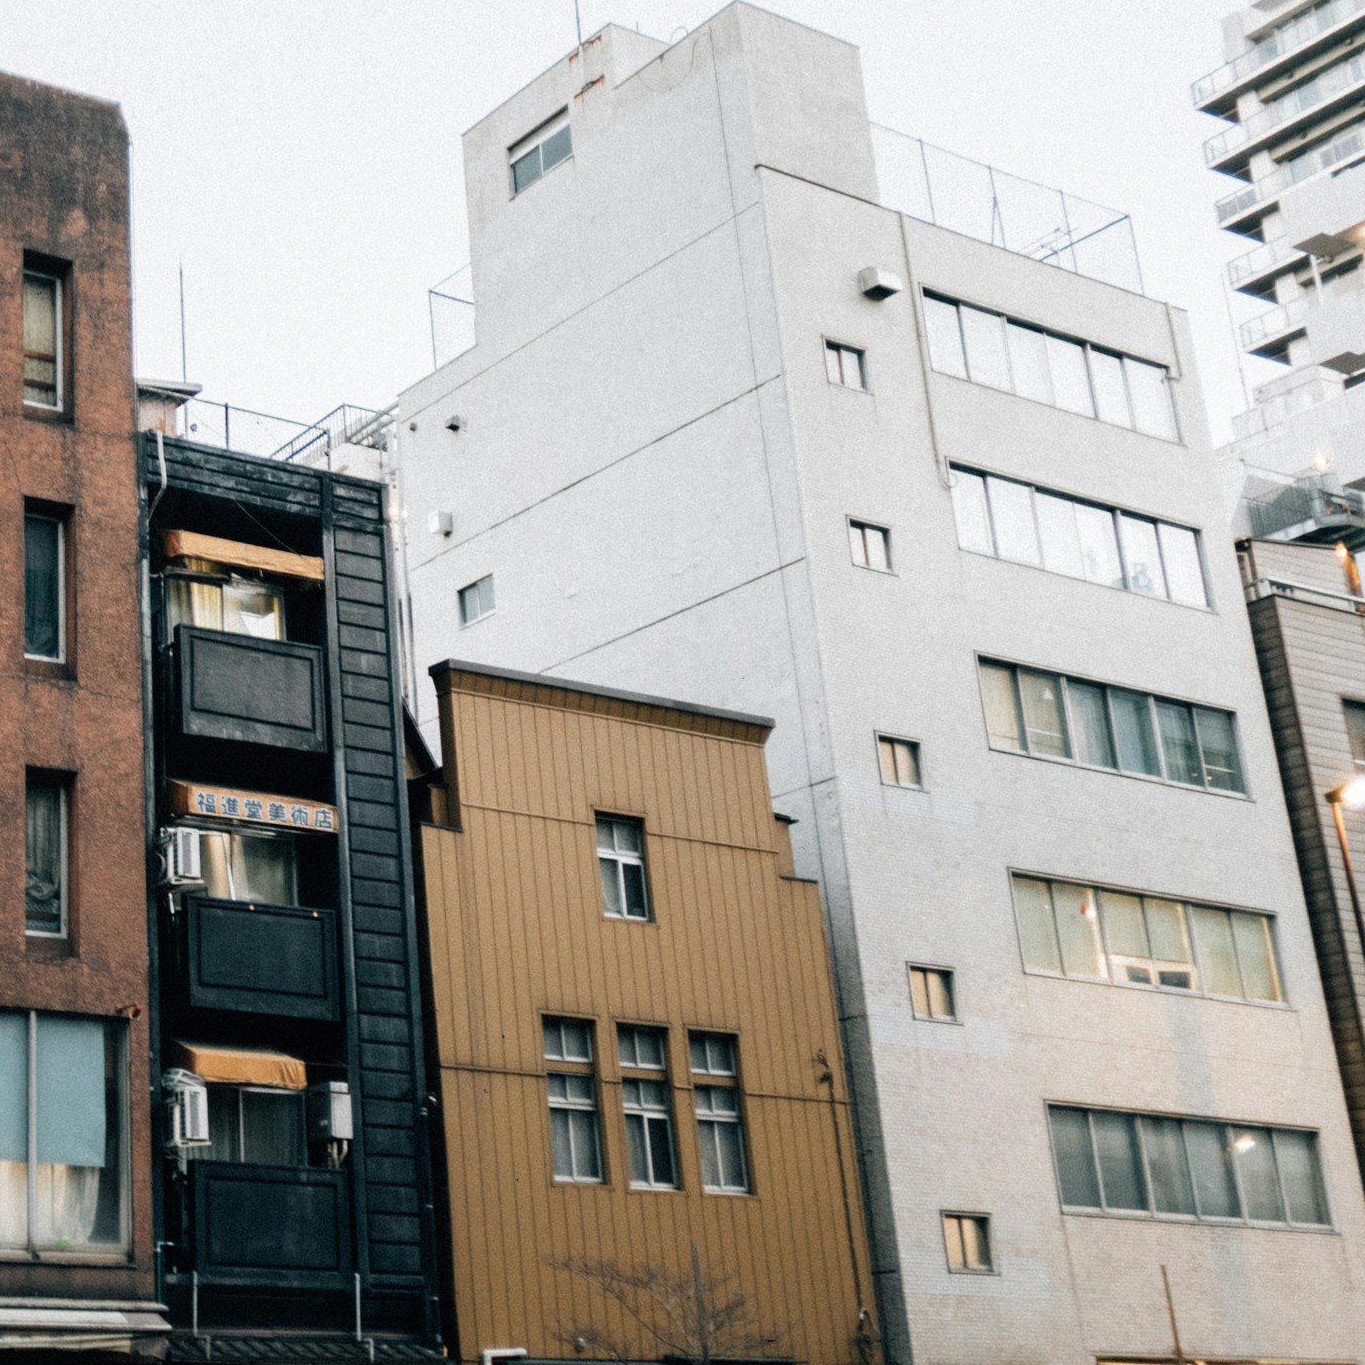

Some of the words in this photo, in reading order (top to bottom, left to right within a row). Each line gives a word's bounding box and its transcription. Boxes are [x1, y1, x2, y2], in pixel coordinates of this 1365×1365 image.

[197, 793, 333, 829] 福進堂美術店
